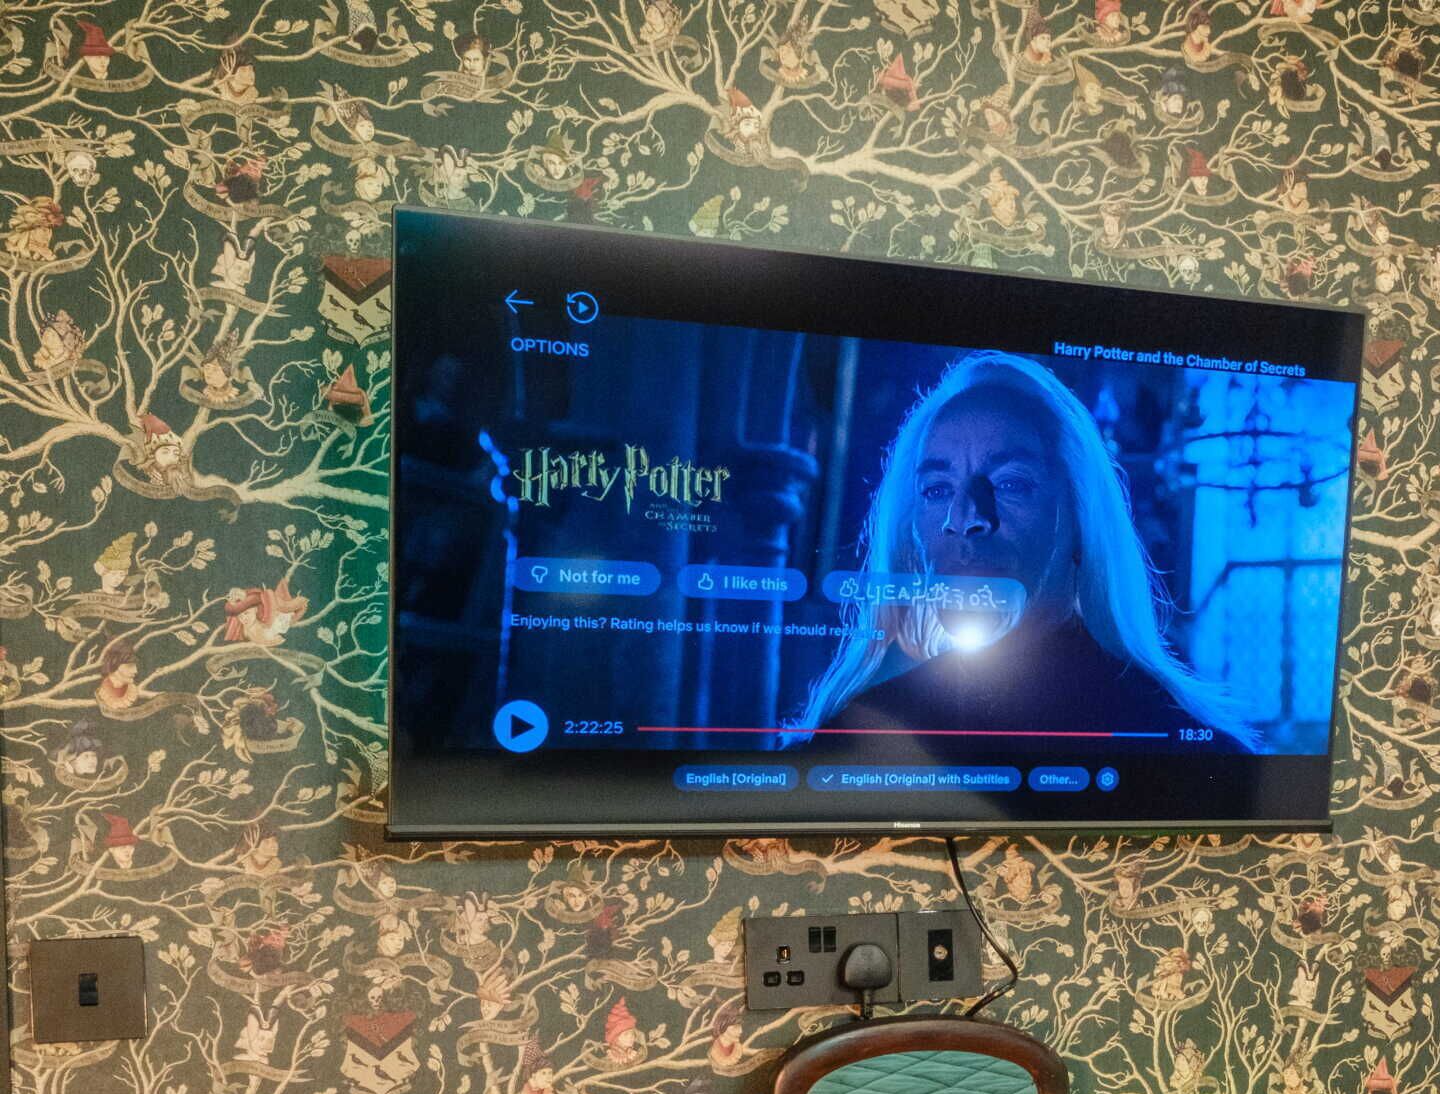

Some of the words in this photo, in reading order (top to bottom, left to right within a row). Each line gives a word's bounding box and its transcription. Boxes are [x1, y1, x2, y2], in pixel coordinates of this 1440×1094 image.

[510, 336, 590, 357] OPTIONS
[1053, 341, 1092, 360] Harry
[1094, 345, 1134, 362] Potter
[1136, 350, 1161, 364] and
[1163, 351, 1184, 366] the
[1186, 354, 1243, 373] Chamber
[1245, 359, 1258, 373] of
[1259, 361, 1306, 377] Secrets
[513, 446, 621, 507] Harry
[623, 443, 731, 515] Potter
[559, 568, 590, 584] Not
[591, 568, 615, 584] for
[617, 573, 641, 585] me
[723, 575, 729, 588] I
[731, 576, 759, 590] like
[761, 577, 788, 591] this
[510, 613, 570, 630] Enjoying
[574, 615, 607, 629] this?
[610, 616, 654, 633] Rating
[657, 618, 693, 633] helps
[696, 622, 711, 632] us
[714, 620, 749, 633] know
[751, 620, 761, 633] if
[763, 623, 782, 634] we
[784, 622, 828, 636] should
[564, 720, 624, 734] 2:22:25
[1178, 727, 1213, 741] 18:30
[686, 772, 730, 785] English
[731, 772, 787, 786] [Original]
[841, 773, 883, 786] English
[884, 773, 936, 786] [Original]
[938, 773, 961, 785] with
[962, 773, 1010, 786] Subtitles
[1039, 773, 1079, 785] Other...
